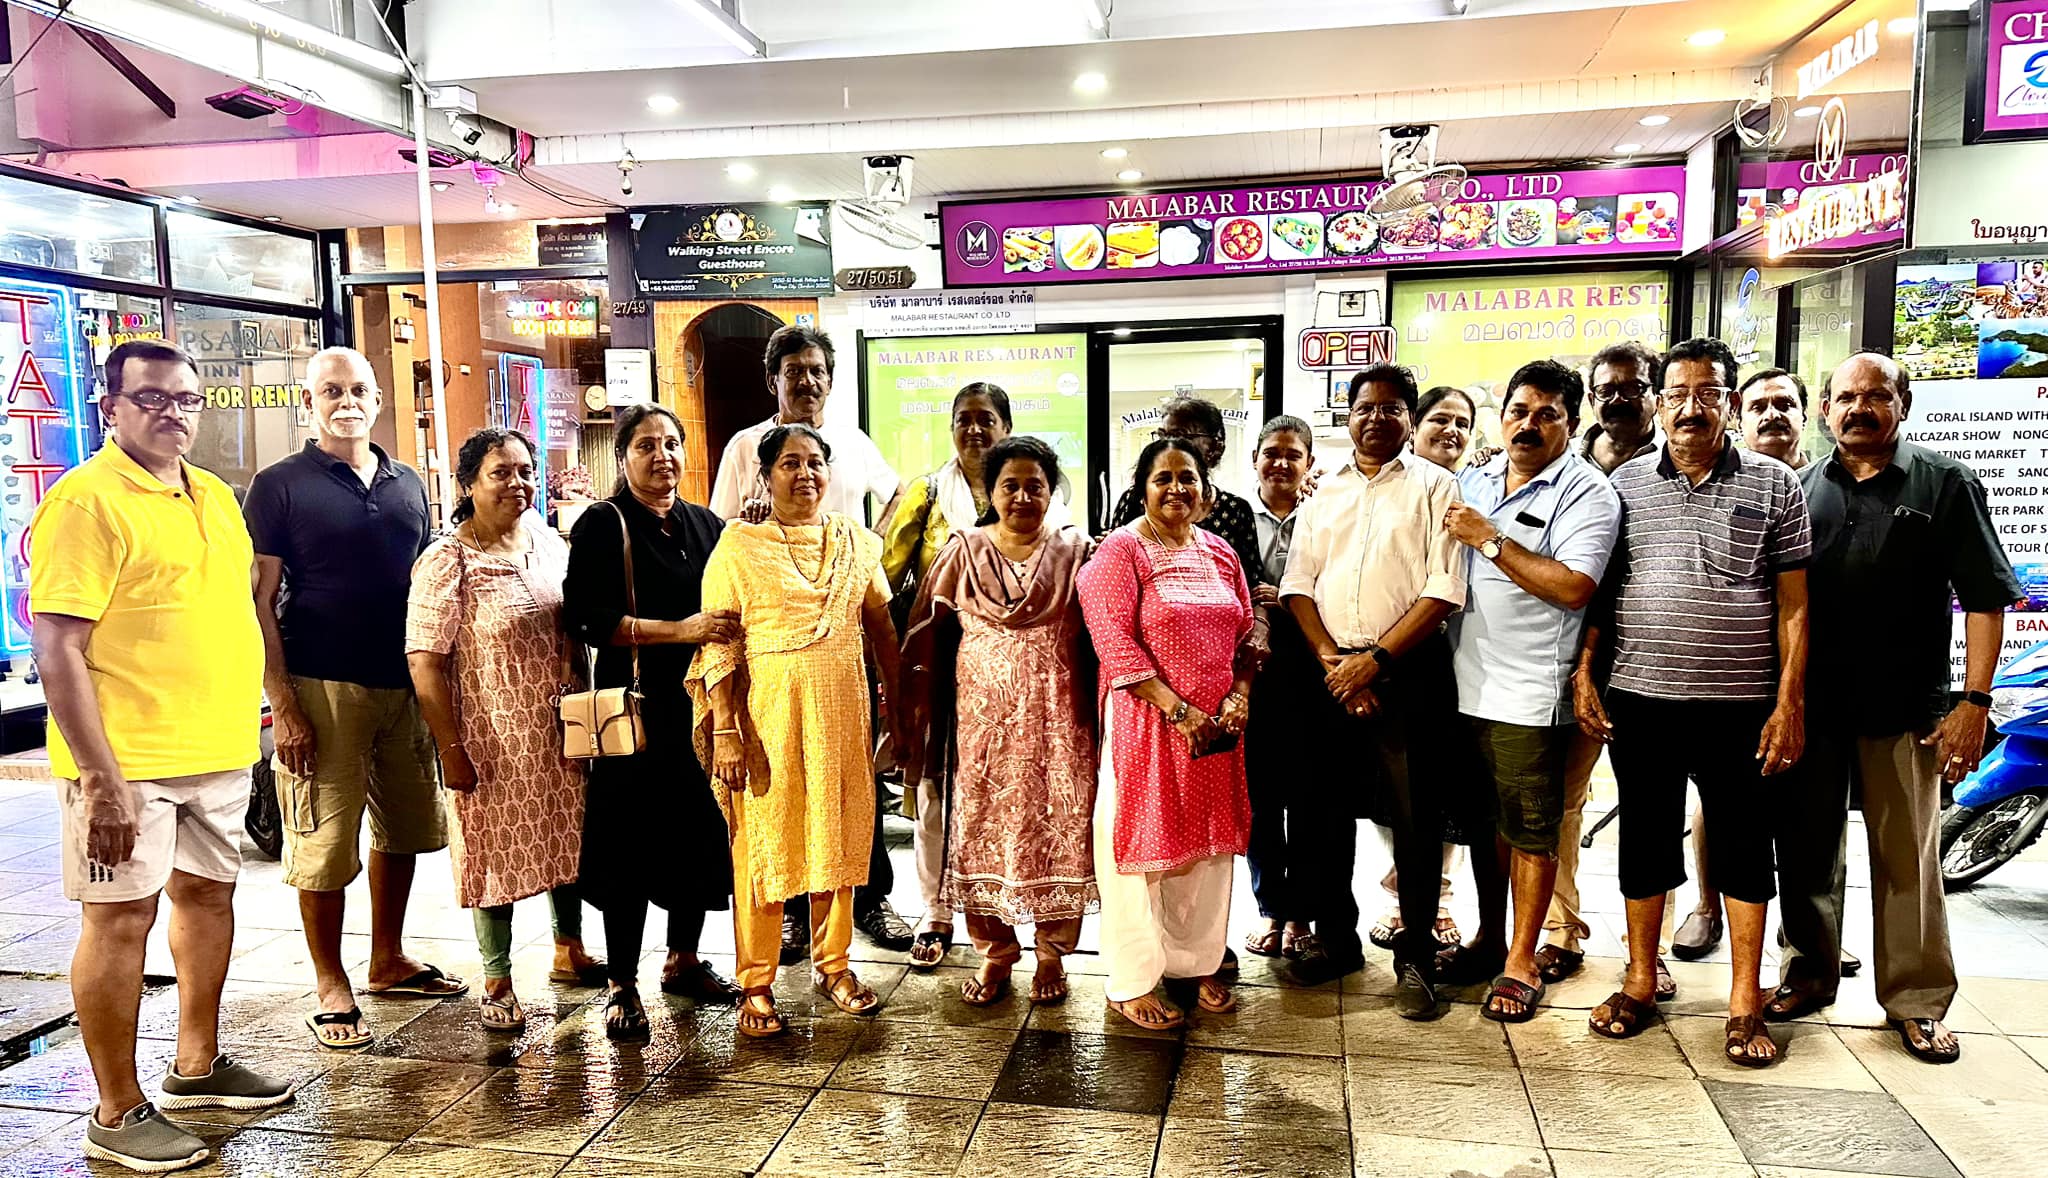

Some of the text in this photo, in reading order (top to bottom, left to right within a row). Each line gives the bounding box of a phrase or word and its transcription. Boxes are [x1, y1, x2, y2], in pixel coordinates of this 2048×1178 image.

[1107, 192, 1236, 220] MALABAR
[1506, 174, 1562, 198] LTD
[668, 244, 795, 257] Walking Street Encore
[698, 259, 765, 270] Guesthouse
[869, 294, 897, 309] บริษัท
[1008, 288, 1034, 304] จำกัด
[1425, 286, 1575, 313] MALABAR
[612, 301, 646, 315] 27/49
[891, 314, 926, 322] MALABAR
[928, 312, 979, 321] RESTAURANT
[1303, 331, 1393, 366] OPEN
[878, 350, 959, 365] MALABAR
[204, 365, 239, 377] INN
[205, 384, 302, 409] FOR RENT
[1223, 409, 1249, 421] rant
[1926, 410, 2048, 423] CORAL ISLAND WITH
[1905, 432, 1959, 442] ALCAZAR
[1962, 431, 2001, 441] SHOW
[1974, 449, 2026, 460] MARKET
[1992, 486, 2038, 497] WORLD
[1988, 505, 2044, 516] TER PARK
[2021, 524, 2037, 534] OF
[2008, 543, 2041, 553] TOUR
[2004, 640, 2031, 649] AND
